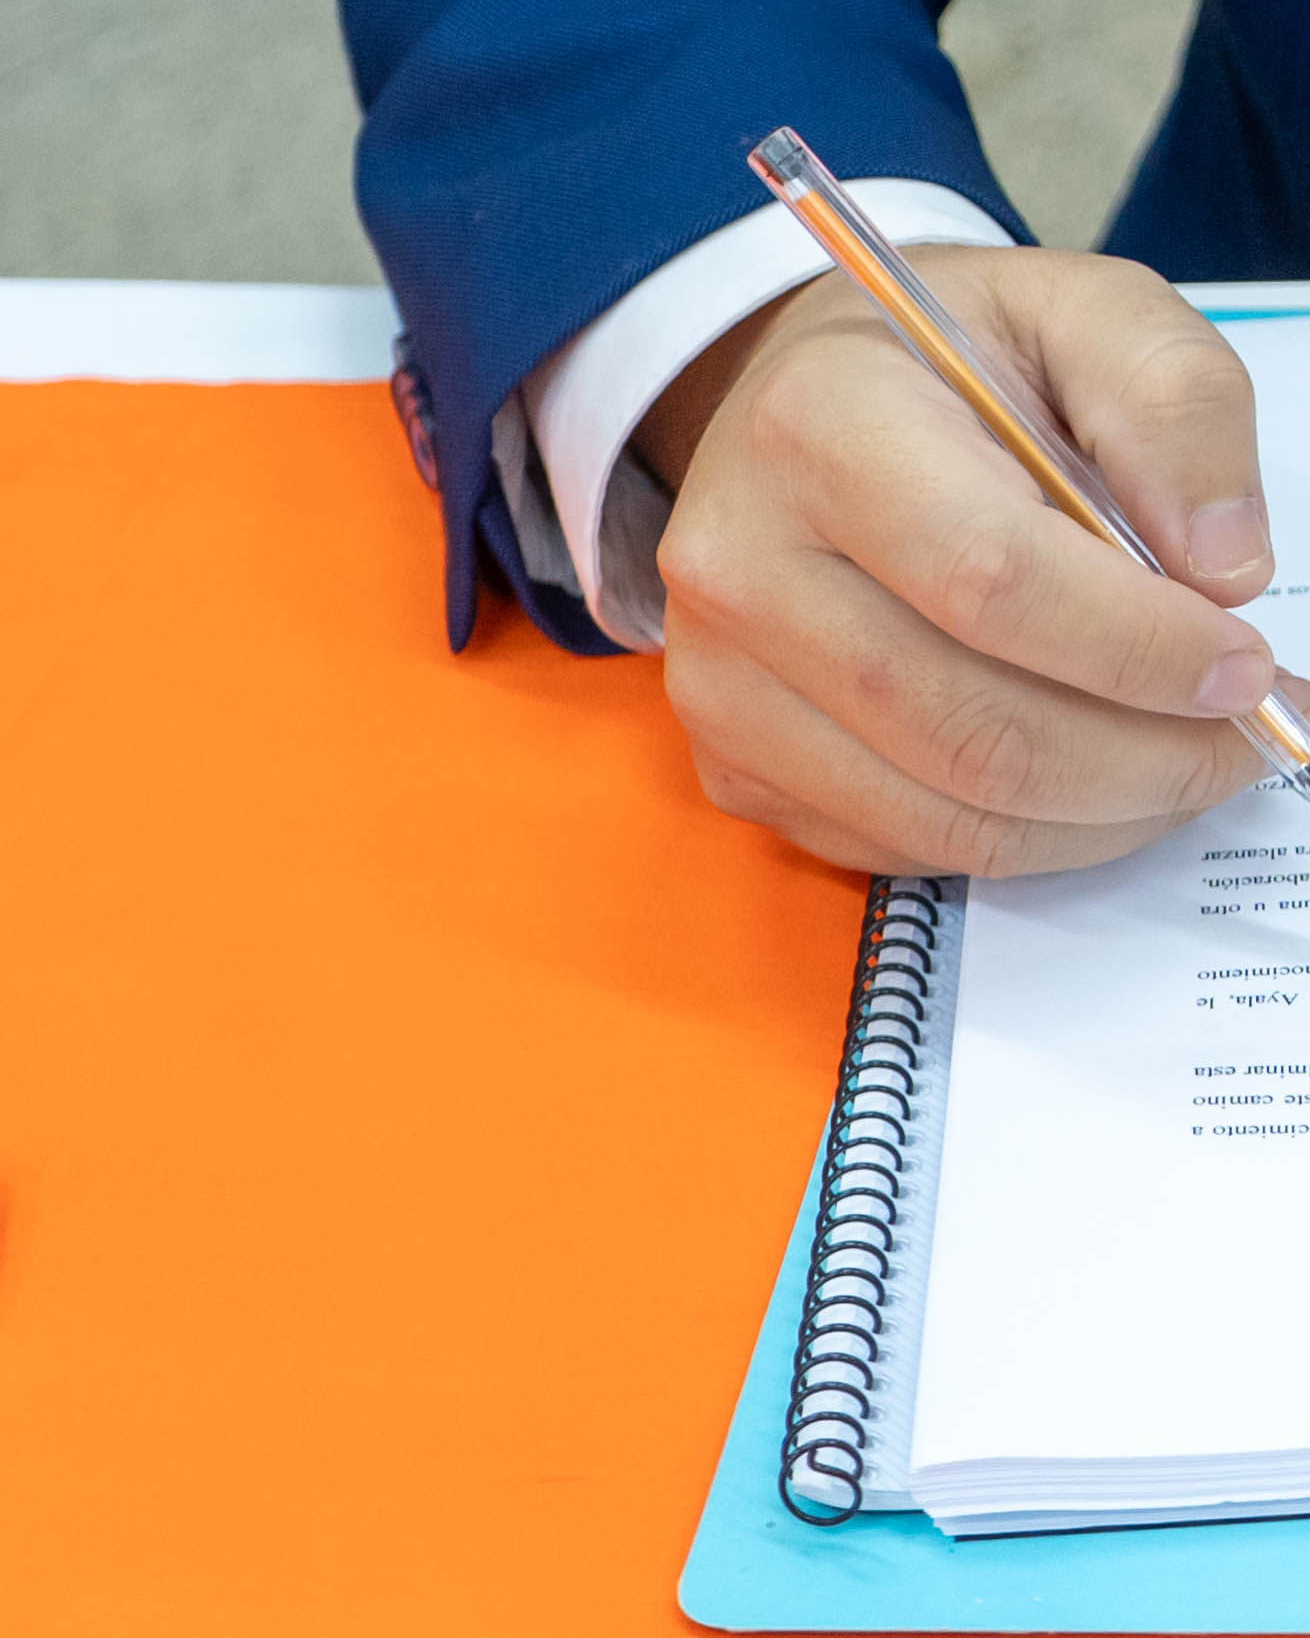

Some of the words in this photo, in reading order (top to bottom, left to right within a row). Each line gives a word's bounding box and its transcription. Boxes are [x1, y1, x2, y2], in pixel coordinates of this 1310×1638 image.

[1200, 846, 1288, 862] alcanzar
[1199, 903, 1241, 916] otra
[1253, 901, 1267, 912] u
[1196, 996, 1215, 1010] le
[1229, 990, 1299, 1008] Ayala,
[1193, 1065, 1237, 1078] esta
[1190, 1094, 1274, 1110] camino
[1192, 1125, 1204, 1136] a
